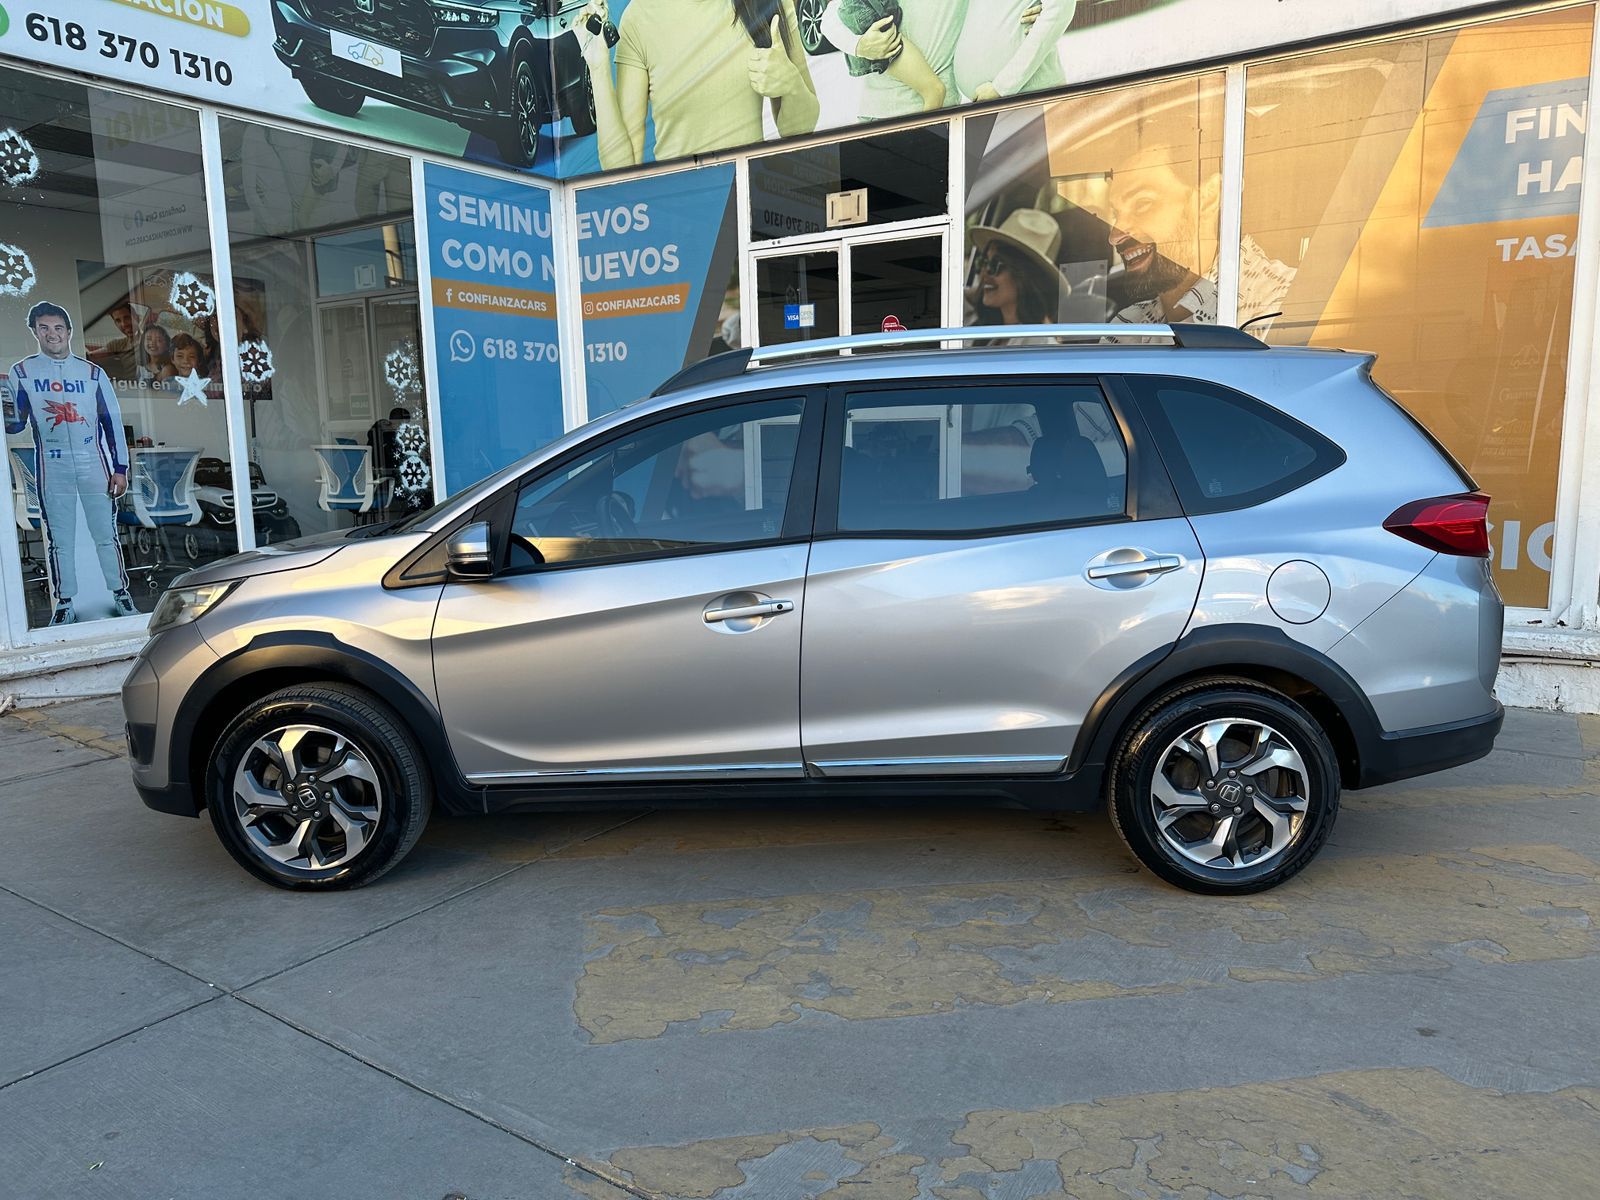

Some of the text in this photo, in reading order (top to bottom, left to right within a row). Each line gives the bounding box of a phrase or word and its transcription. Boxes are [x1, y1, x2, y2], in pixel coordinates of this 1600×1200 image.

[25, 12, 233, 86] 618 370 1310
[1505, 100, 1587, 144] FIN
[438, 191, 552, 239] SEMINU
[441, 238, 533, 278] COMO
[1496, 233, 1577, 262] TAS
[578, 244, 680, 283] UEVOS
[458, 291, 547, 312] CONFIANZACARS
[595, 294, 681, 312] CONFIANZACARS
[483, 338, 558, 363] 618 370
[586, 341, 628, 363] 1310
[34, 379, 85, 393] Mobil
[152, 381, 171, 391] en
